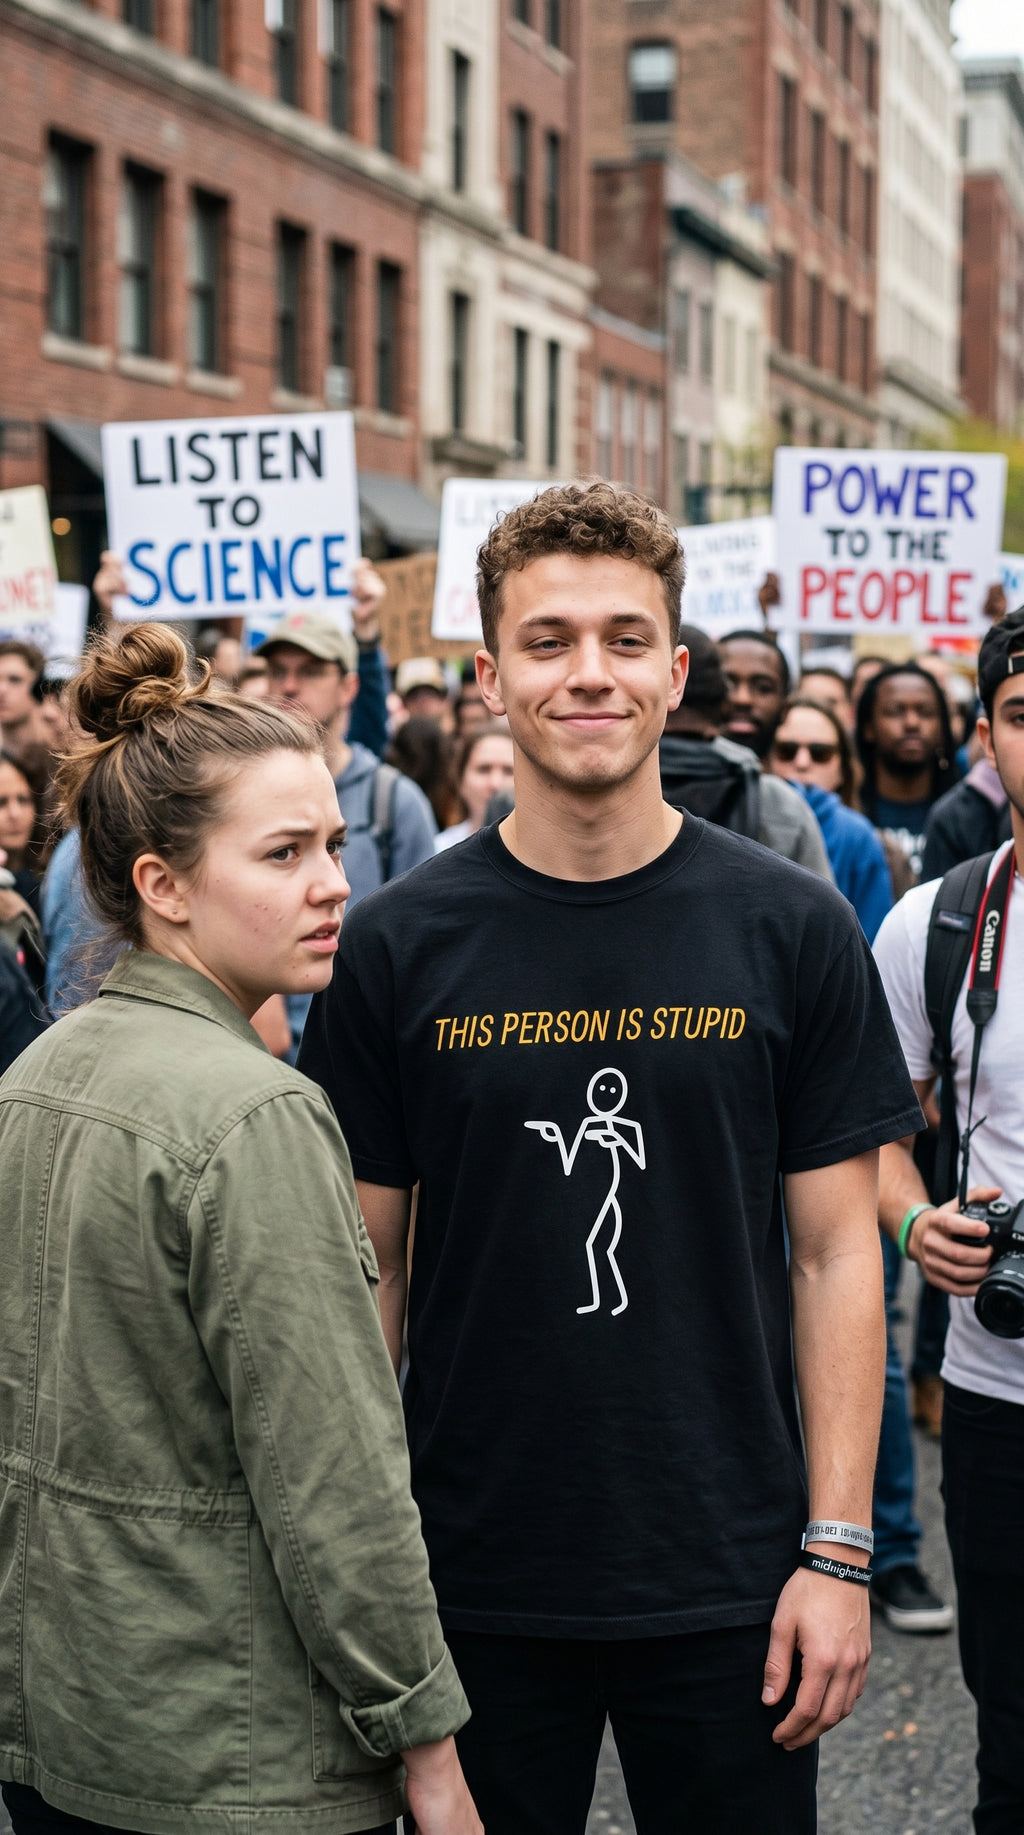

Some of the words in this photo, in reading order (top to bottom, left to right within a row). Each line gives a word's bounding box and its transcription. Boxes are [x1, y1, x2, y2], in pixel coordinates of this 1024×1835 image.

[132, 428, 324, 487] LISTEN
[197, 494, 261, 530] TO
[803, 461, 977, 521] POWER
[127, 534, 352, 607] SCIENCE
[823, 527, 870, 559] TO
[884, 528, 949, 562] THE
[800, 565, 973, 626] PEOPLE
[979, 909, 1000, 972] Canon
[435, 1014, 495, 1051] THIS
[500, 1009, 611, 1045] PERSON
[616, 1007, 644, 1041] IS
[650, 1006, 746, 1040] STUPID
